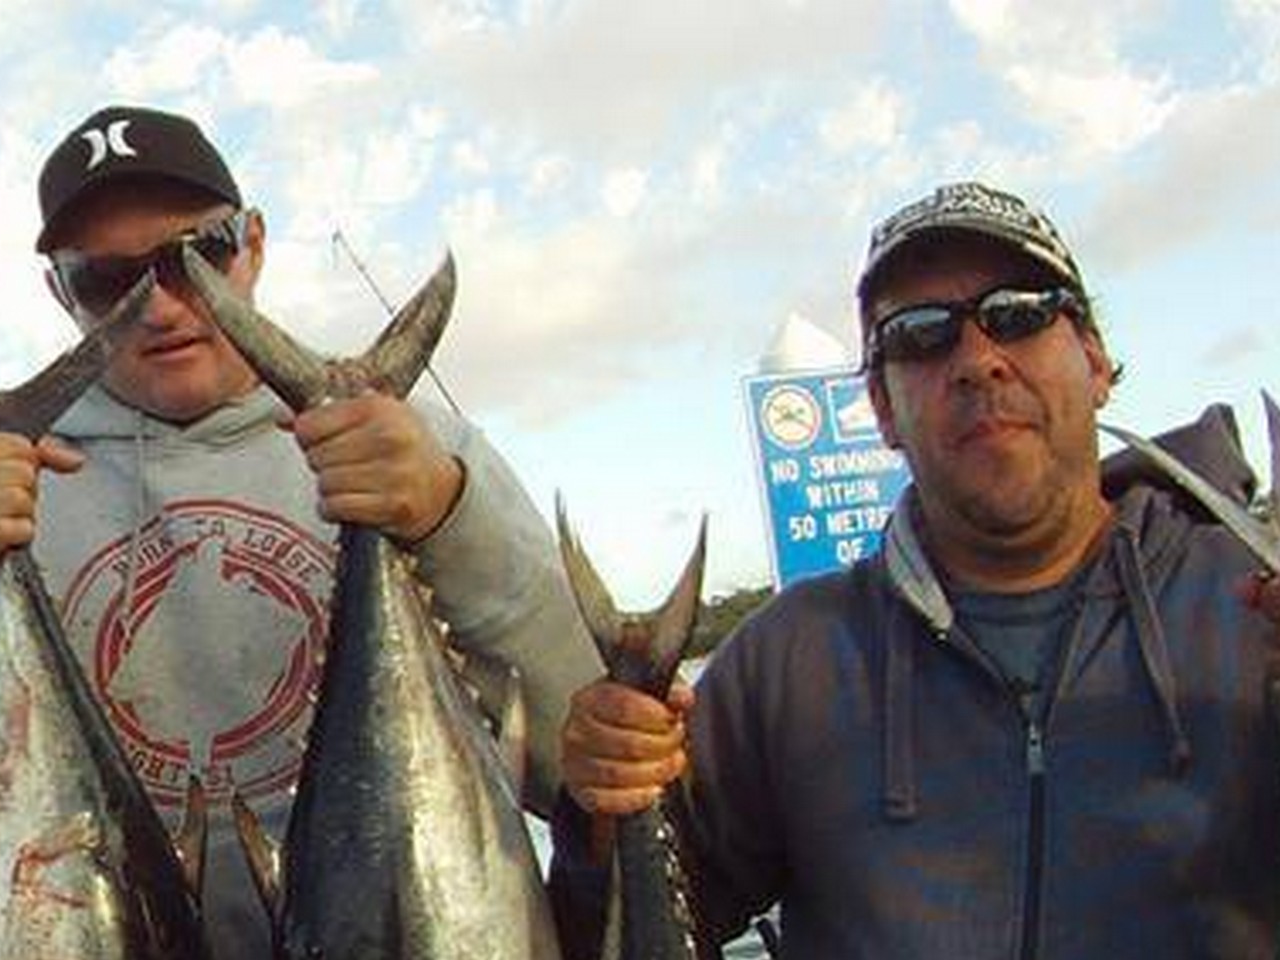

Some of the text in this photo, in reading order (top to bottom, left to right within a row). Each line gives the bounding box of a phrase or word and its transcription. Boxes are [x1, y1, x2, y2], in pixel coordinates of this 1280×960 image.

[768, 460, 800, 485] NO
[806, 479, 880, 509] WITHIN
[789, 514, 818, 541] 50
